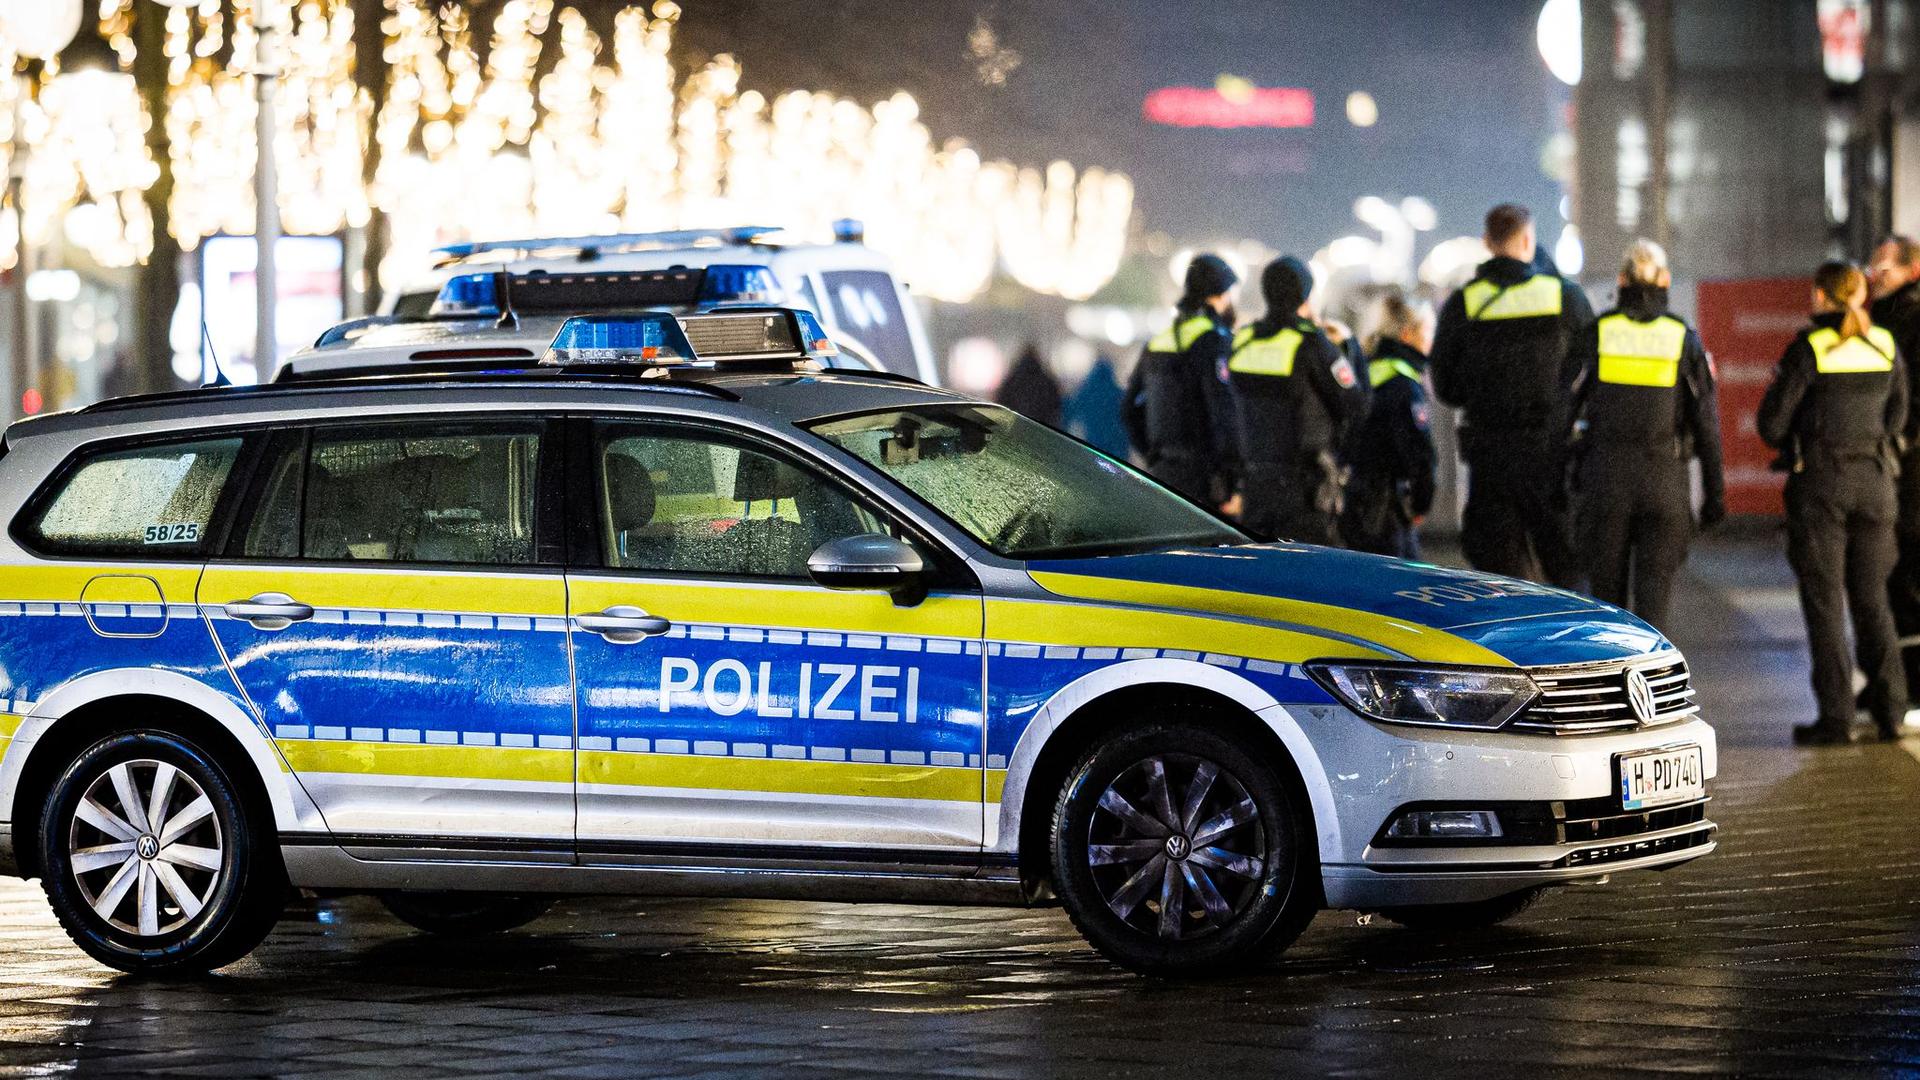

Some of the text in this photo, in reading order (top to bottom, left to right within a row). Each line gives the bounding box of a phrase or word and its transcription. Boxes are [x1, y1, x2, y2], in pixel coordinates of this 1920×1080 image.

[144, 523, 198, 542] 58/25
[1394, 579, 1550, 607] POLIZ
[659, 656, 920, 724] POLIZEI
[1634, 761, 1645, 795] H
